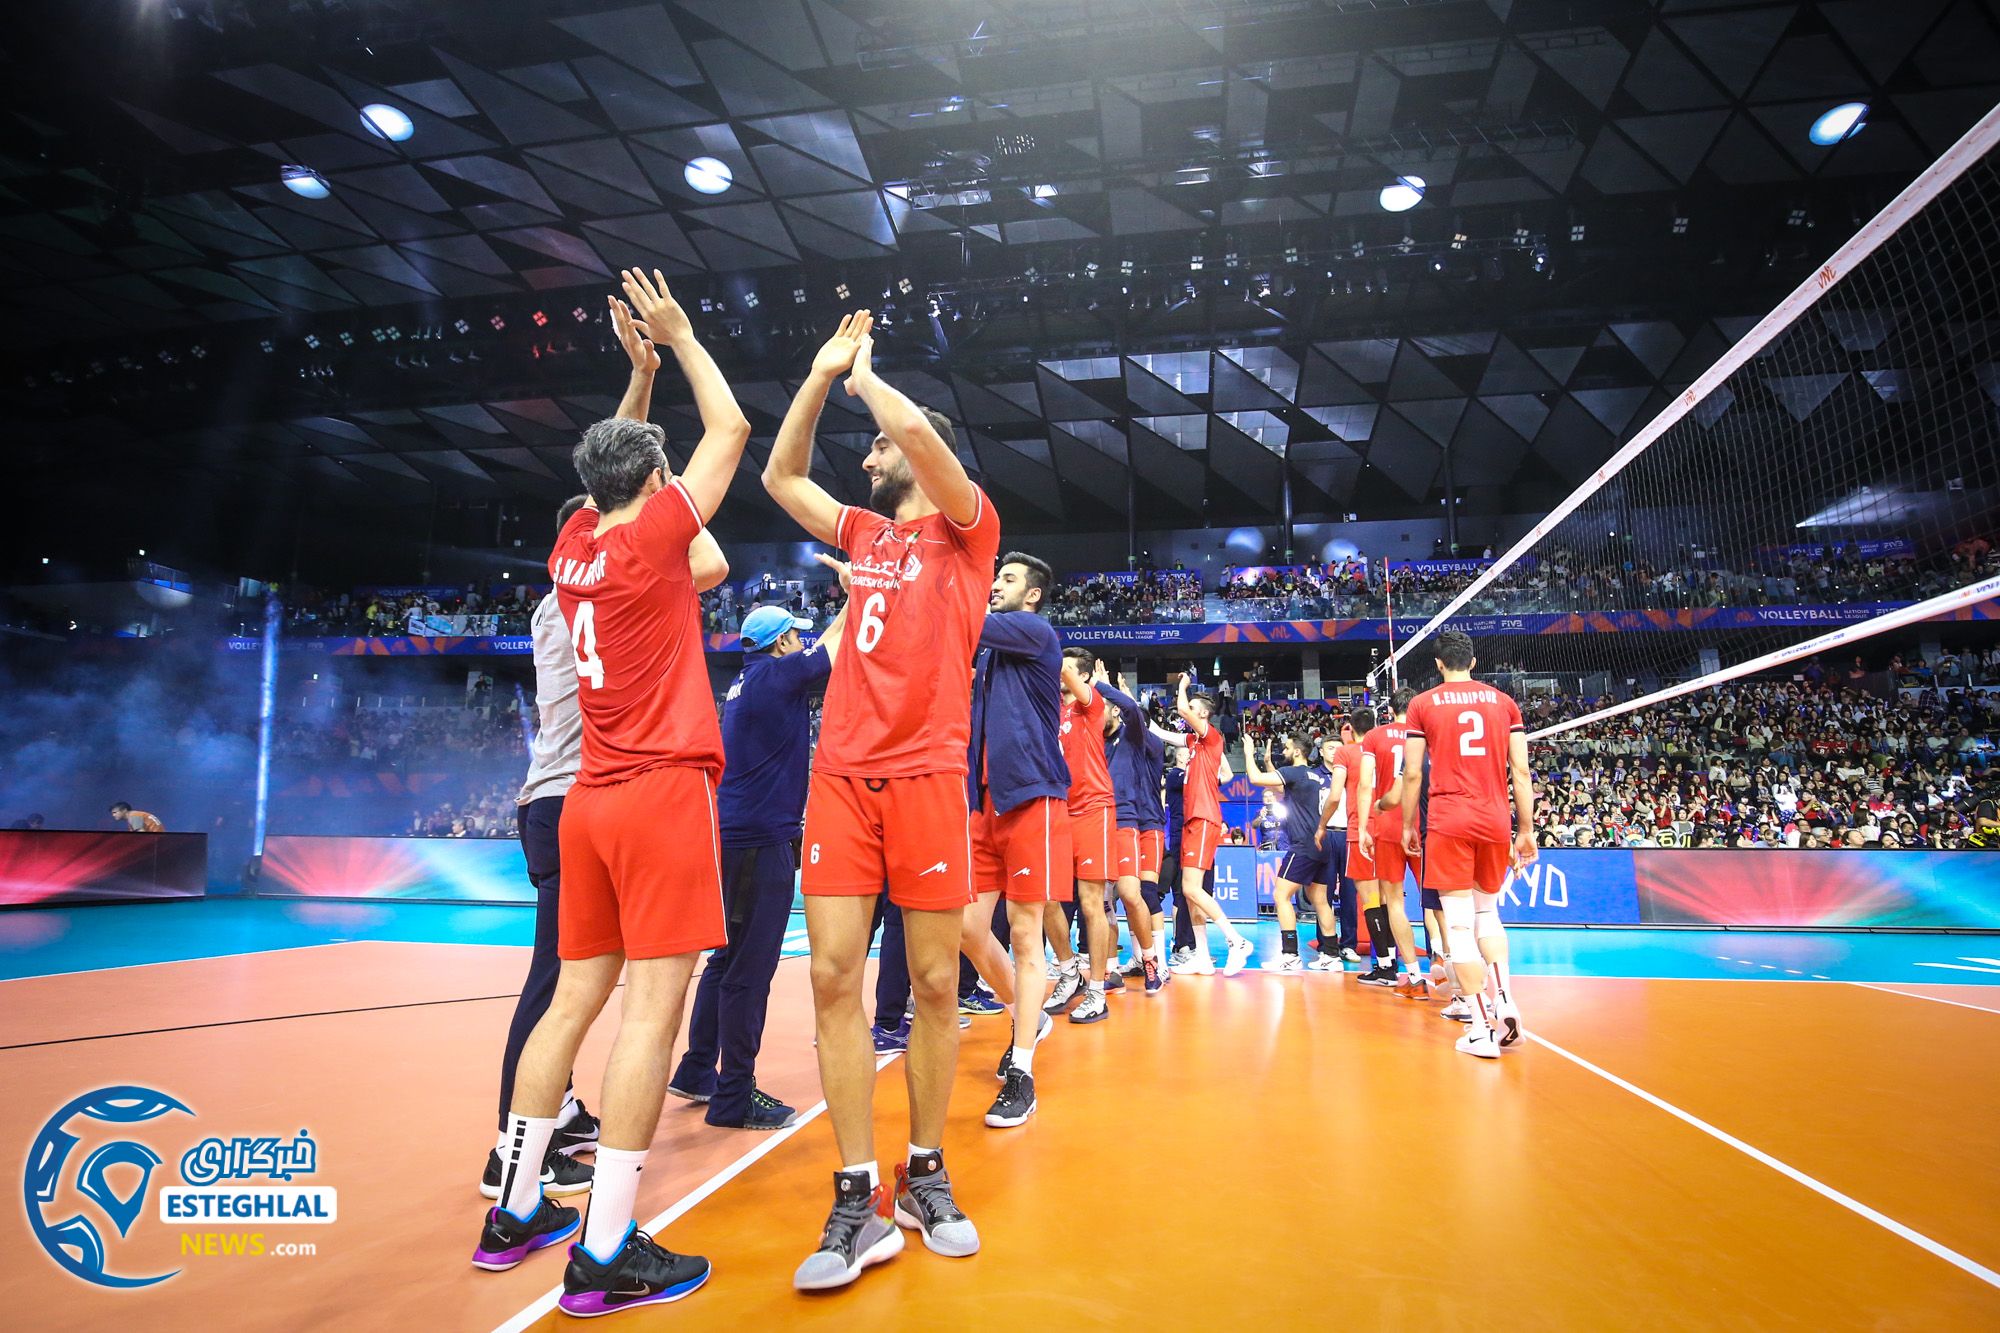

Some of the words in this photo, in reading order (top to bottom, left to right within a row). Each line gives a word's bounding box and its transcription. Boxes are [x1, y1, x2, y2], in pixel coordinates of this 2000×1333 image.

[856, 592, 886, 653] 6
[1758, 609, 1843, 620] VOLLEYBALL
[572, 600, 605, 690] 4
[1066, 630, 1134, 640] VOLLEYBALL
[1457, 710, 1486, 757] 2
[810, 843, 820, 864] 6
